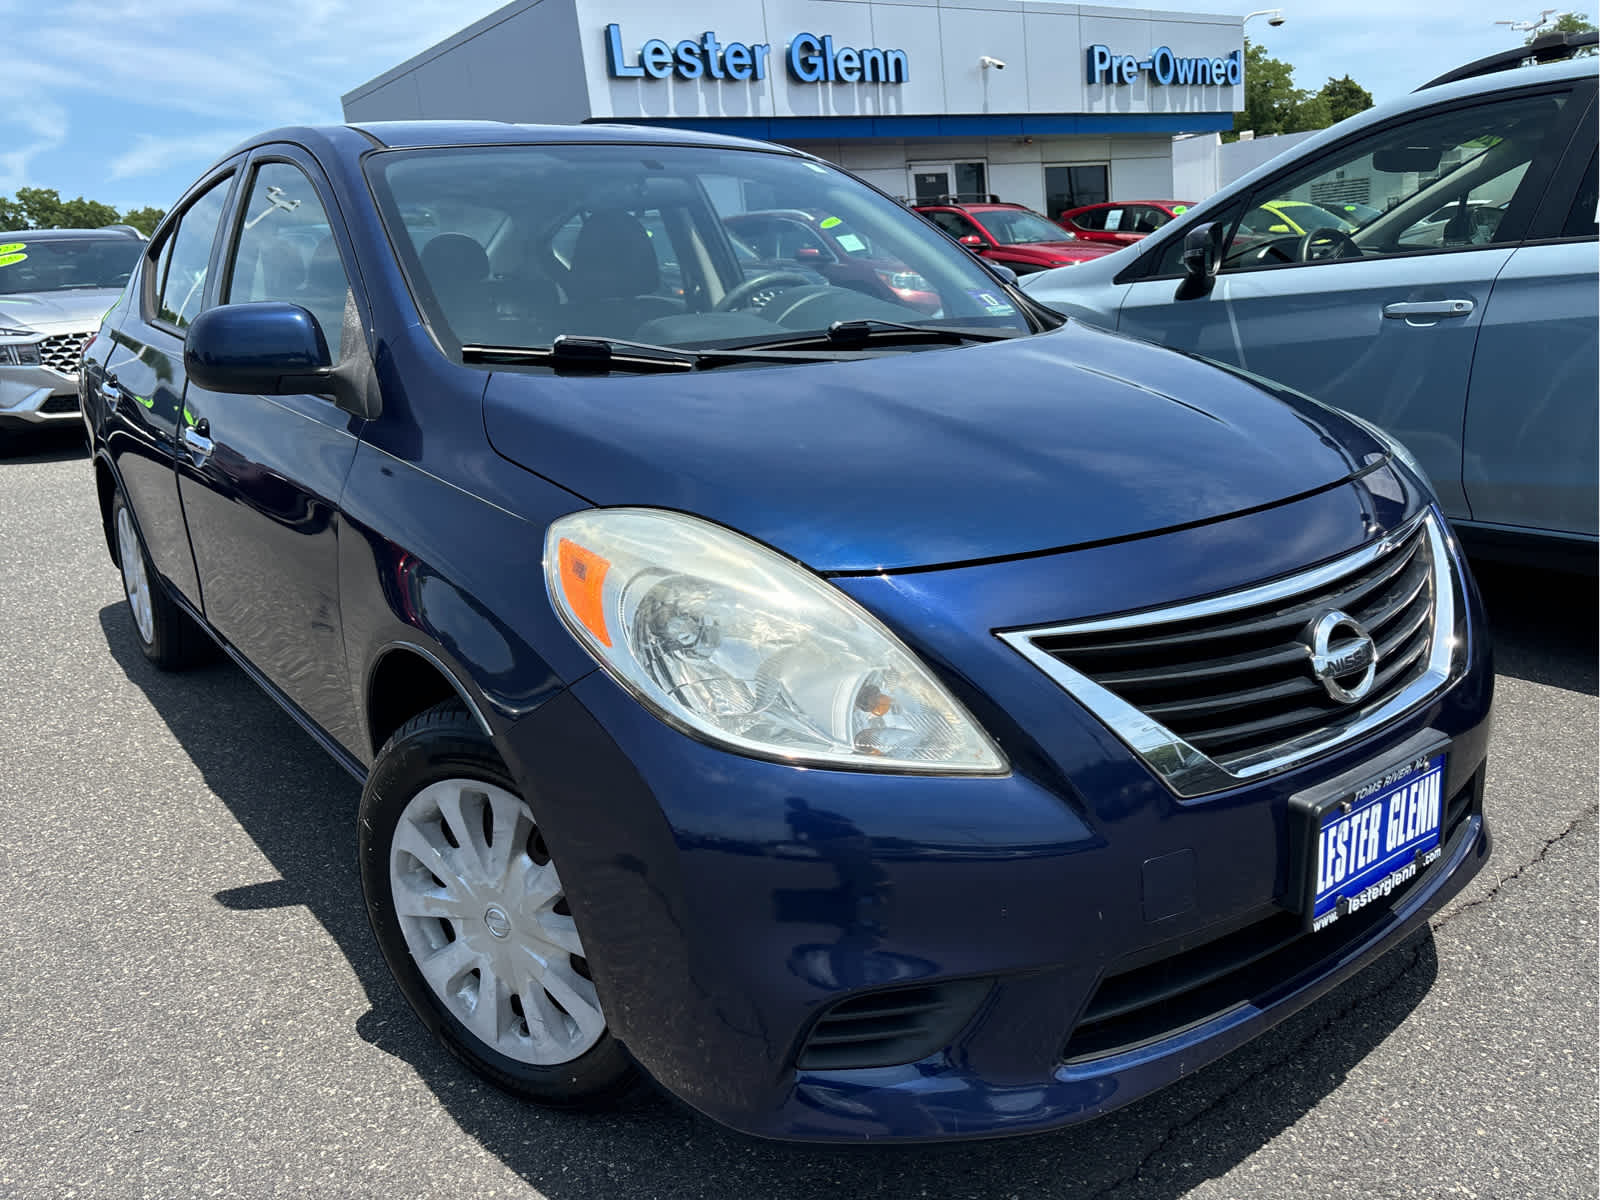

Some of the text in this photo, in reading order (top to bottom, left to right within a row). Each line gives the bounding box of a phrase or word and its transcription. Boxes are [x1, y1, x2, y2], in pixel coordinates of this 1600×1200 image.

[604, 23, 909, 83] Lester Glenn
[1087, 44, 1241, 86] Pre-Owned
[1354, 780, 1382, 802] TOMS
[1317, 770, 1441, 895] LESTER GLENN
